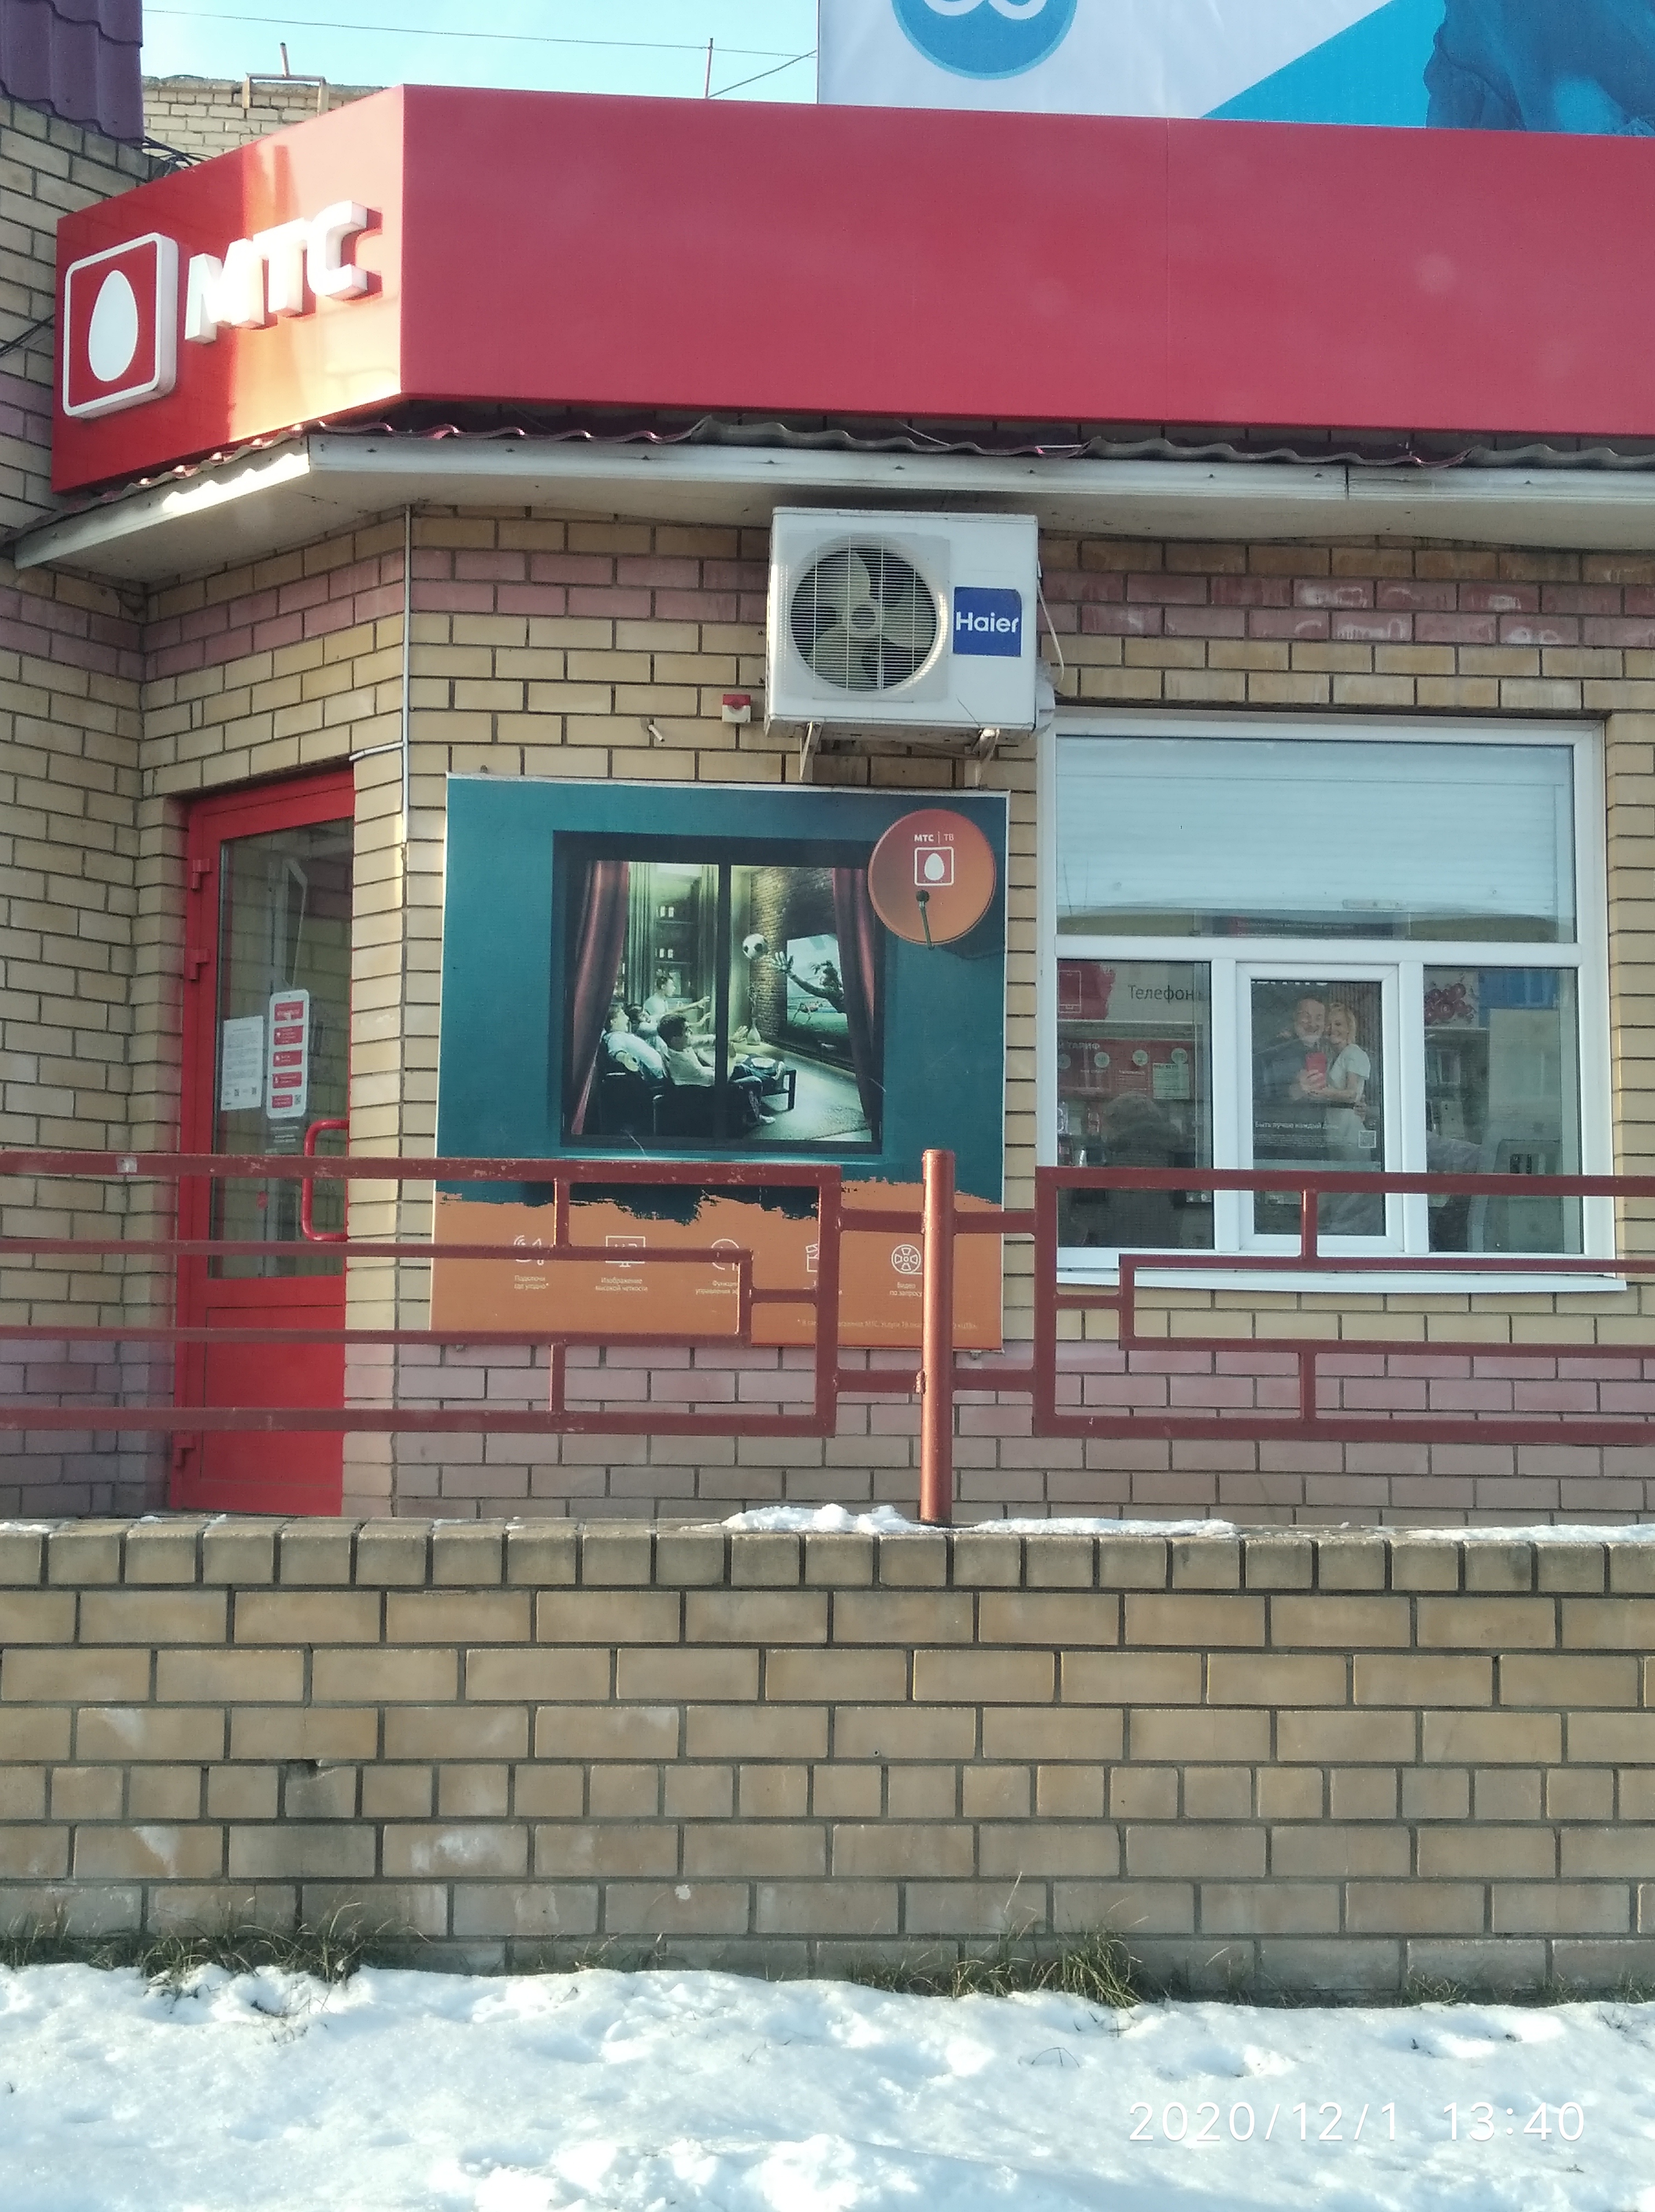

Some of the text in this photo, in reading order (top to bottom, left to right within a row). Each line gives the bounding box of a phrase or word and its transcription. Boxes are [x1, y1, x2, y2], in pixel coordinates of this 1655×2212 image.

[185, 200, 368, 344] МТС
[956, 611, 1019, 633] Haier
[914, 833, 954, 842] МТС ТВ
